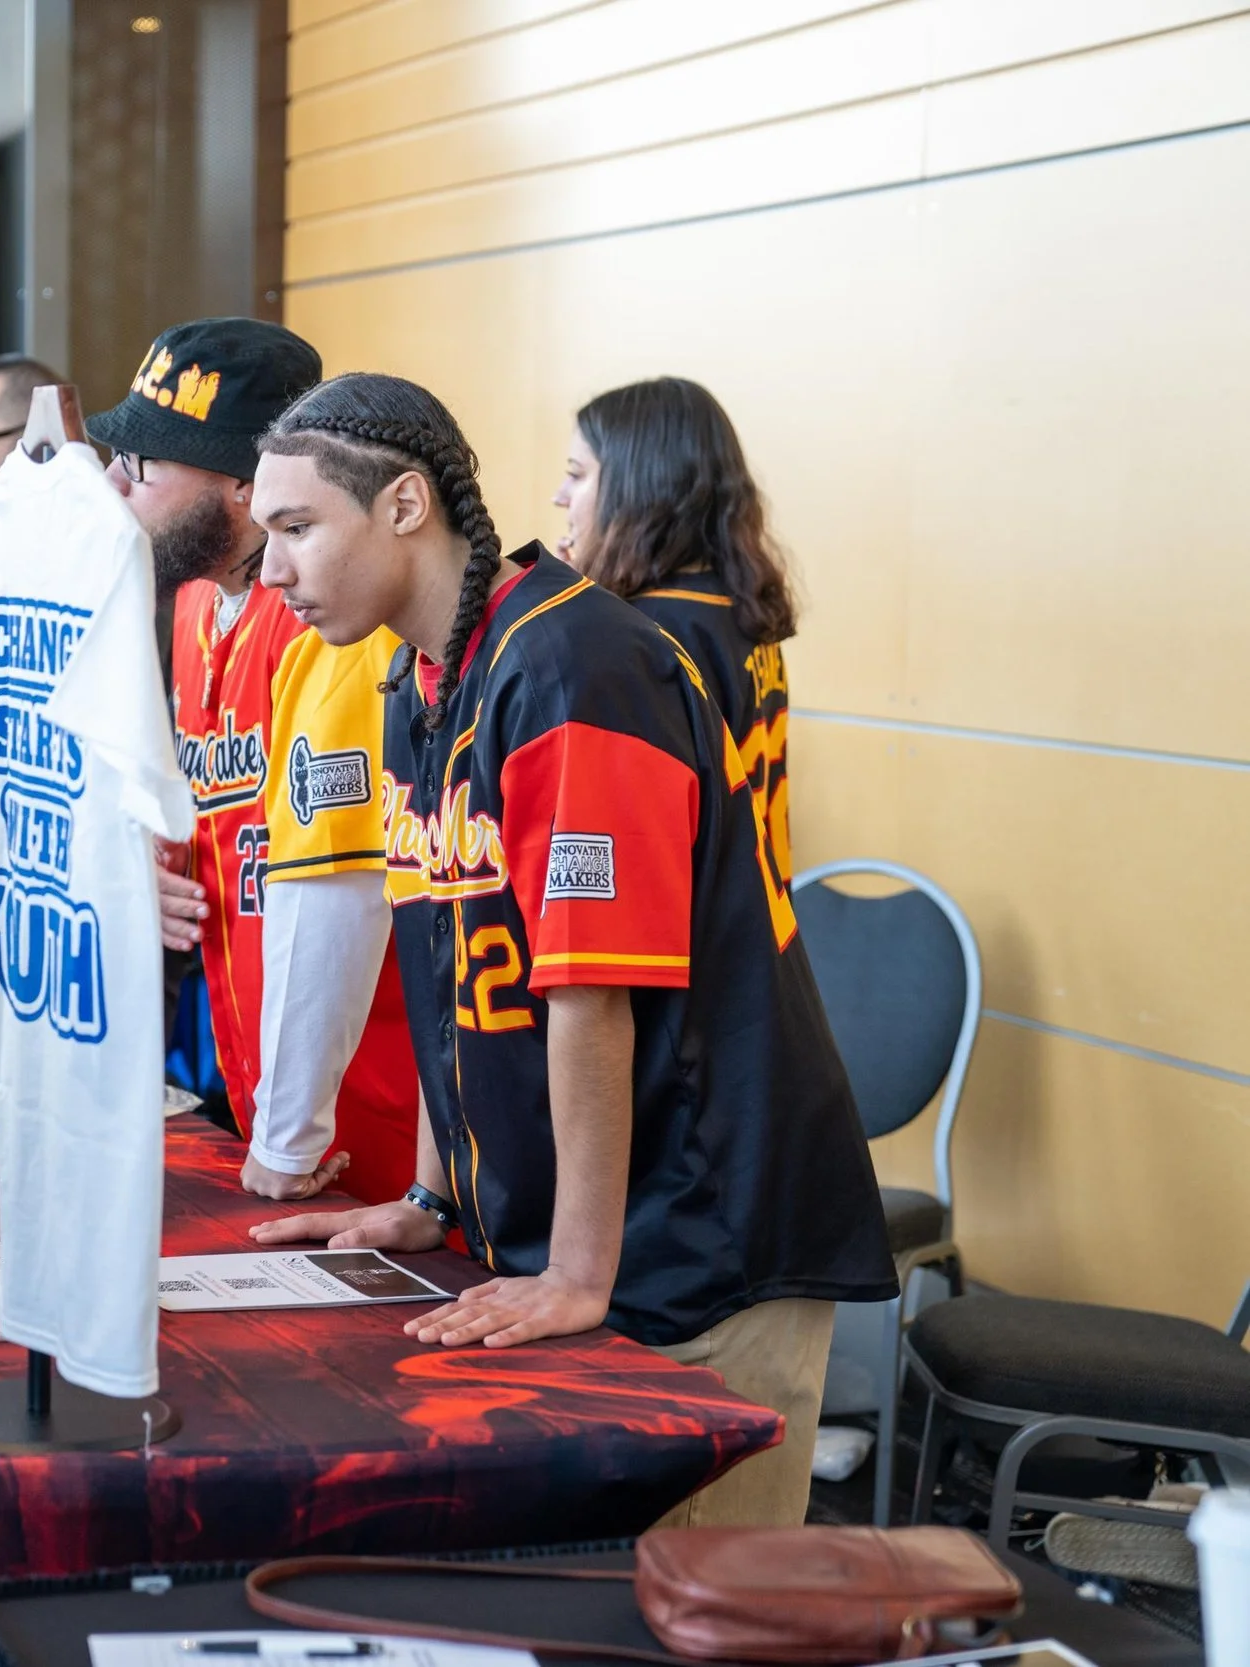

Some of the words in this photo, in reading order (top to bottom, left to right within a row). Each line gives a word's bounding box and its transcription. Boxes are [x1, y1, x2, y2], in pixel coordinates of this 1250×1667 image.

[310, 762, 360, 777] INNOVATIVE
[310, 770, 362, 788] CHANGE
[311, 781, 363, 799] MAKERS
[550, 844, 609, 857] NNOVATIVE
[549, 856, 610, 873] CHANGE
[548, 871, 610, 888] MAKERS
